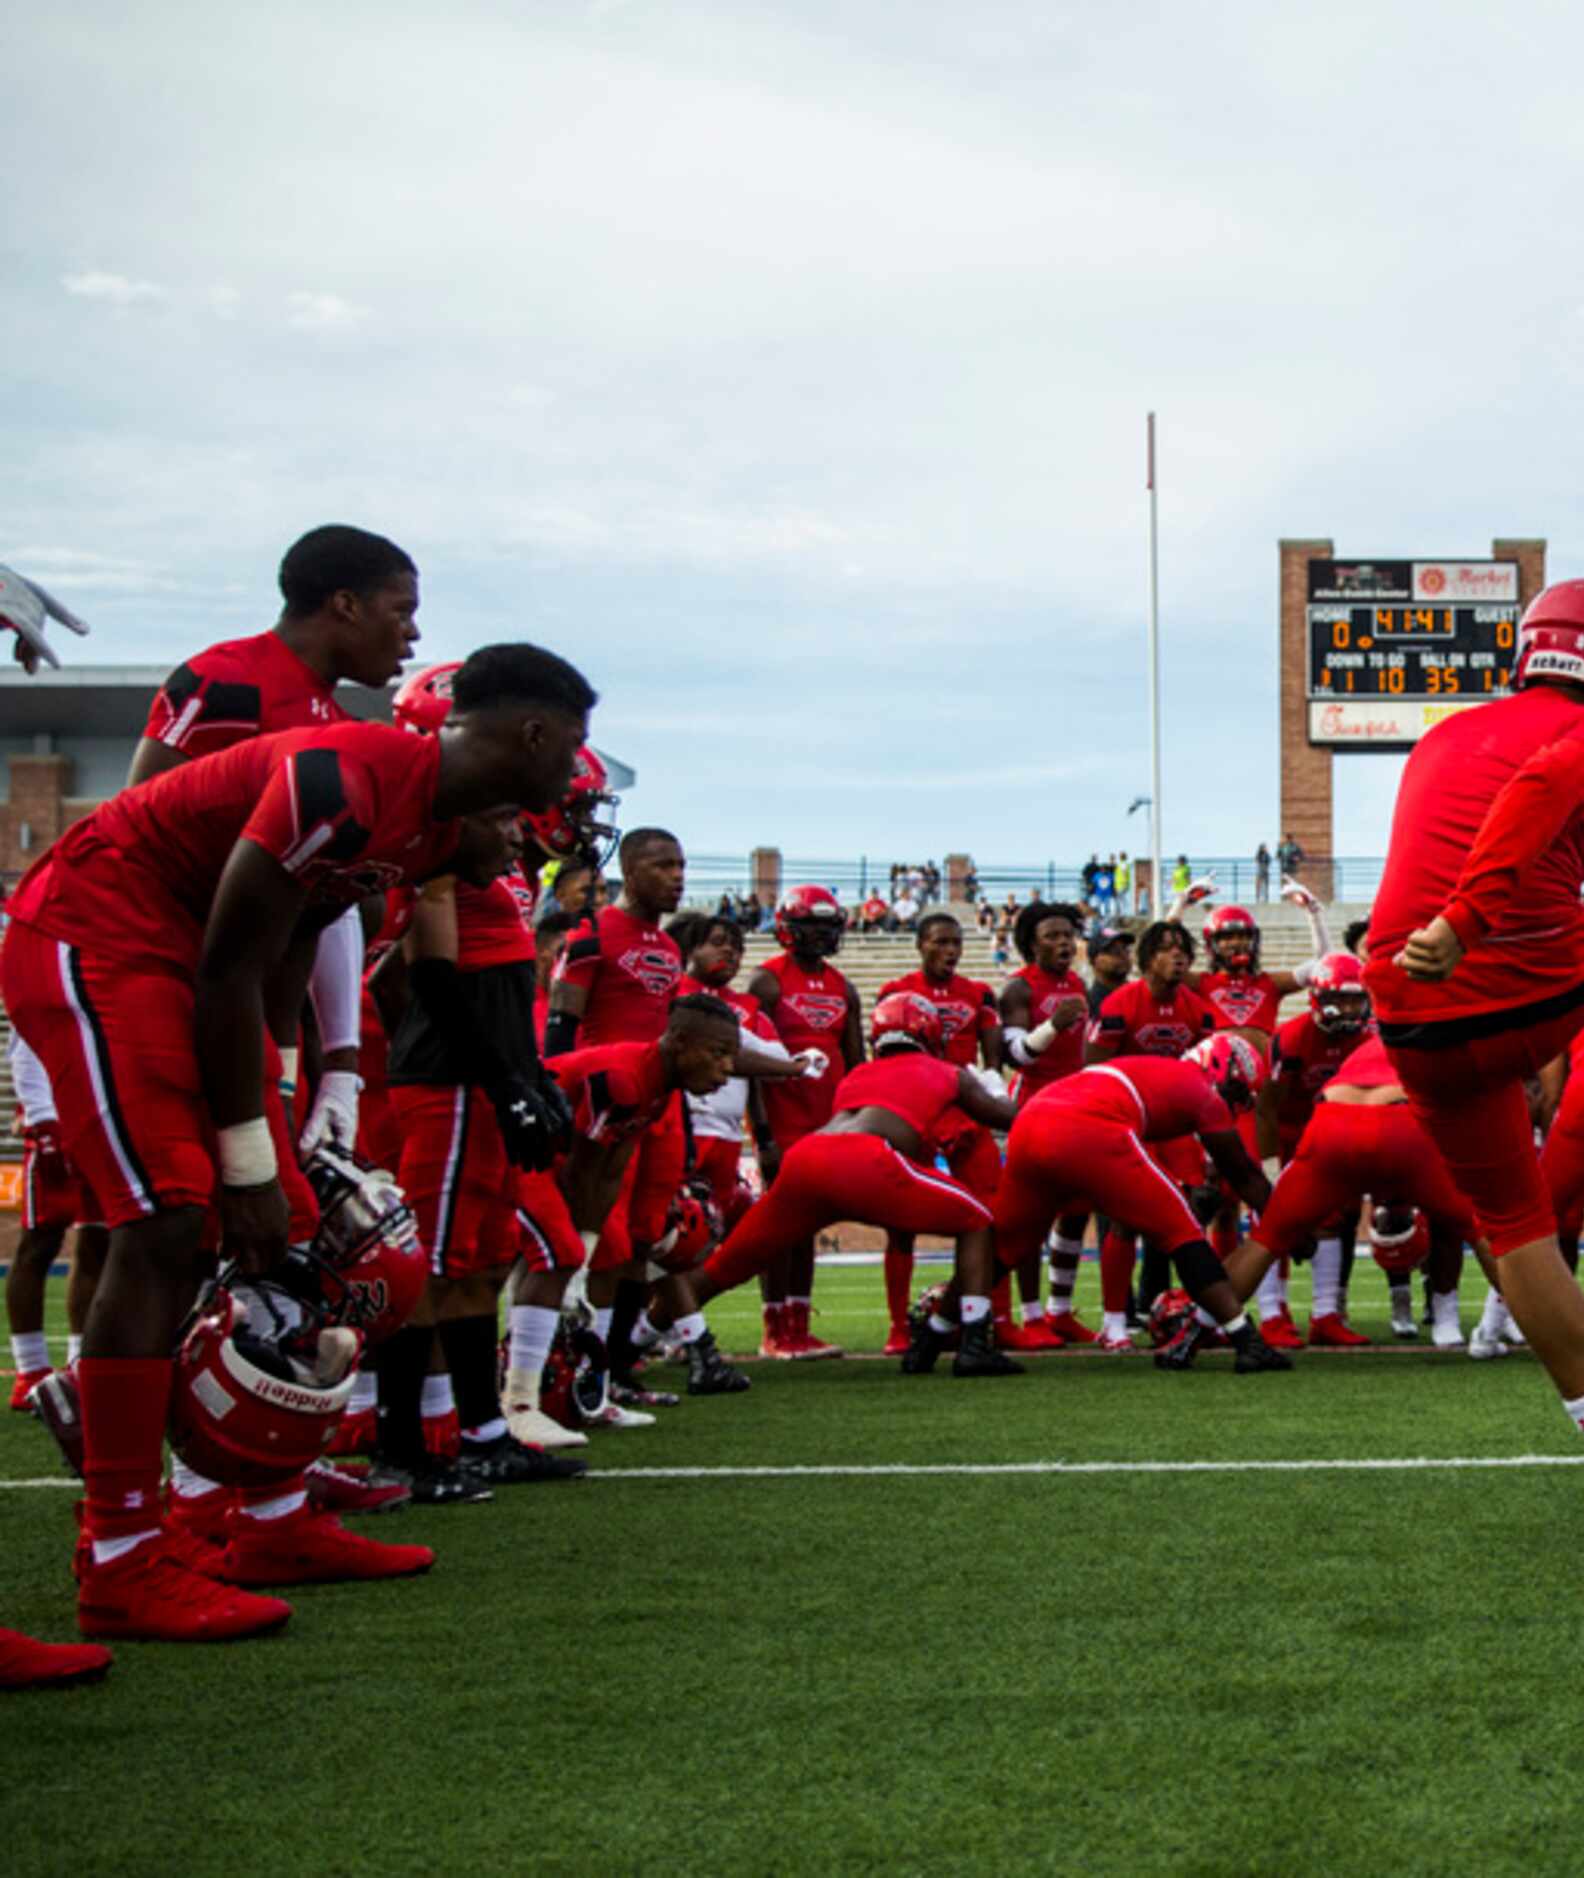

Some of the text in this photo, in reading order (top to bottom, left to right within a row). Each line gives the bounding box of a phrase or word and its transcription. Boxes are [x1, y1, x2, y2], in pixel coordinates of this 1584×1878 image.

[1333, 621, 1350, 648] 0
[1496, 621, 1514, 648] 0
[1379, 666, 1405, 693] 10
[1426, 666, 1460, 693] 35
